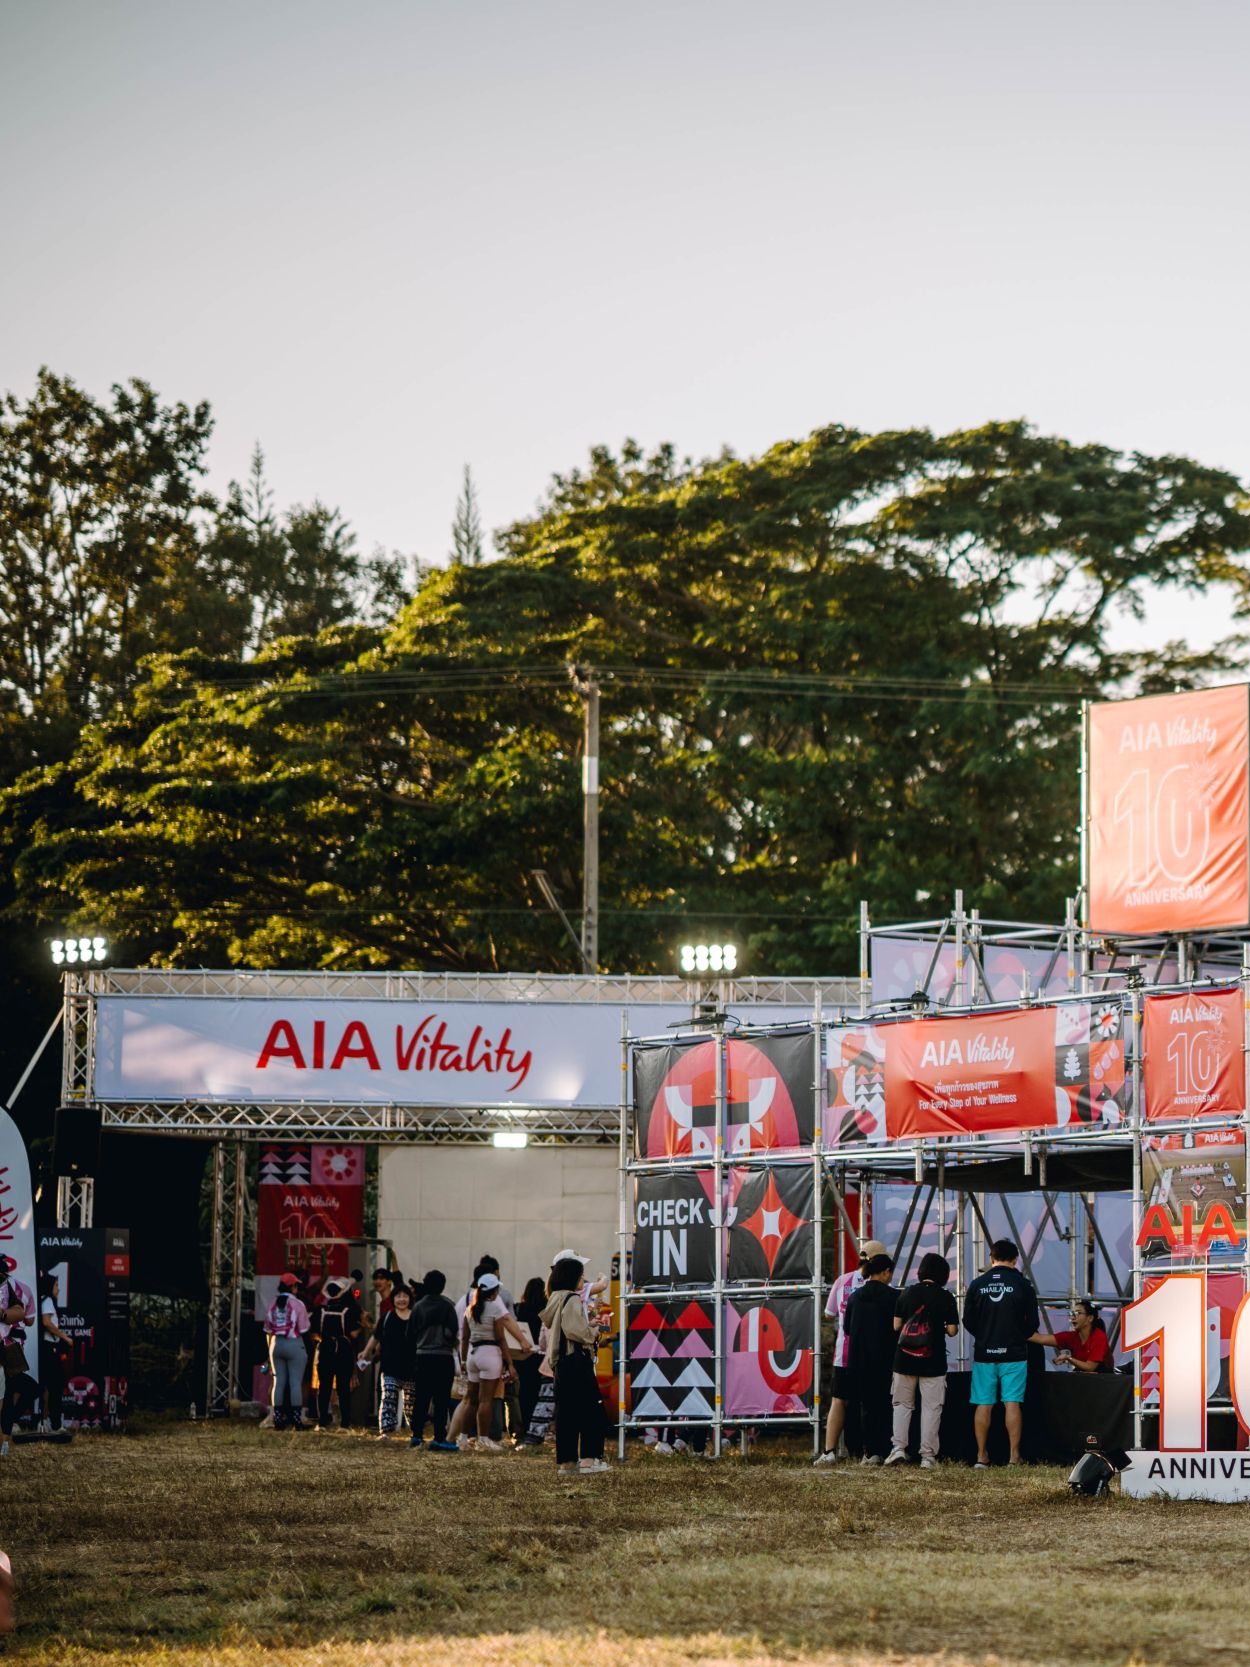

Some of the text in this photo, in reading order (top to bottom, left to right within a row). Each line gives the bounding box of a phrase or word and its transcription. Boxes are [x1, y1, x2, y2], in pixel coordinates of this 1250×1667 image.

[1118, 714, 1218, 756] AIA Vitality
[1112, 763, 1211, 888] 10
[1124, 883, 1210, 907] ANNIVERSARY
[1169, 1005, 1223, 1026] AIA Vitality
[256, 1014, 532, 1092] AIA Vitality
[920, 1032, 1015, 1070] AIA Vitality
[1167, 1030, 1220, 1094] 10
[919, 1093, 1017, 1110] For Every Step of Your Wellness
[1173, 1093, 1220, 1105] ANNIVERSARY
[1204, 1133, 1219, 1143] AIA
[283, 1195, 309, 1207] AIA
[637, 1198, 704, 1228] CHECK
[1136, 1204, 1240, 1246] AIA
[40, 1236, 60, 1247] AIA
[652, 1229, 687, 1277] IN
[979, 1286, 1014, 1294] THAILAND
